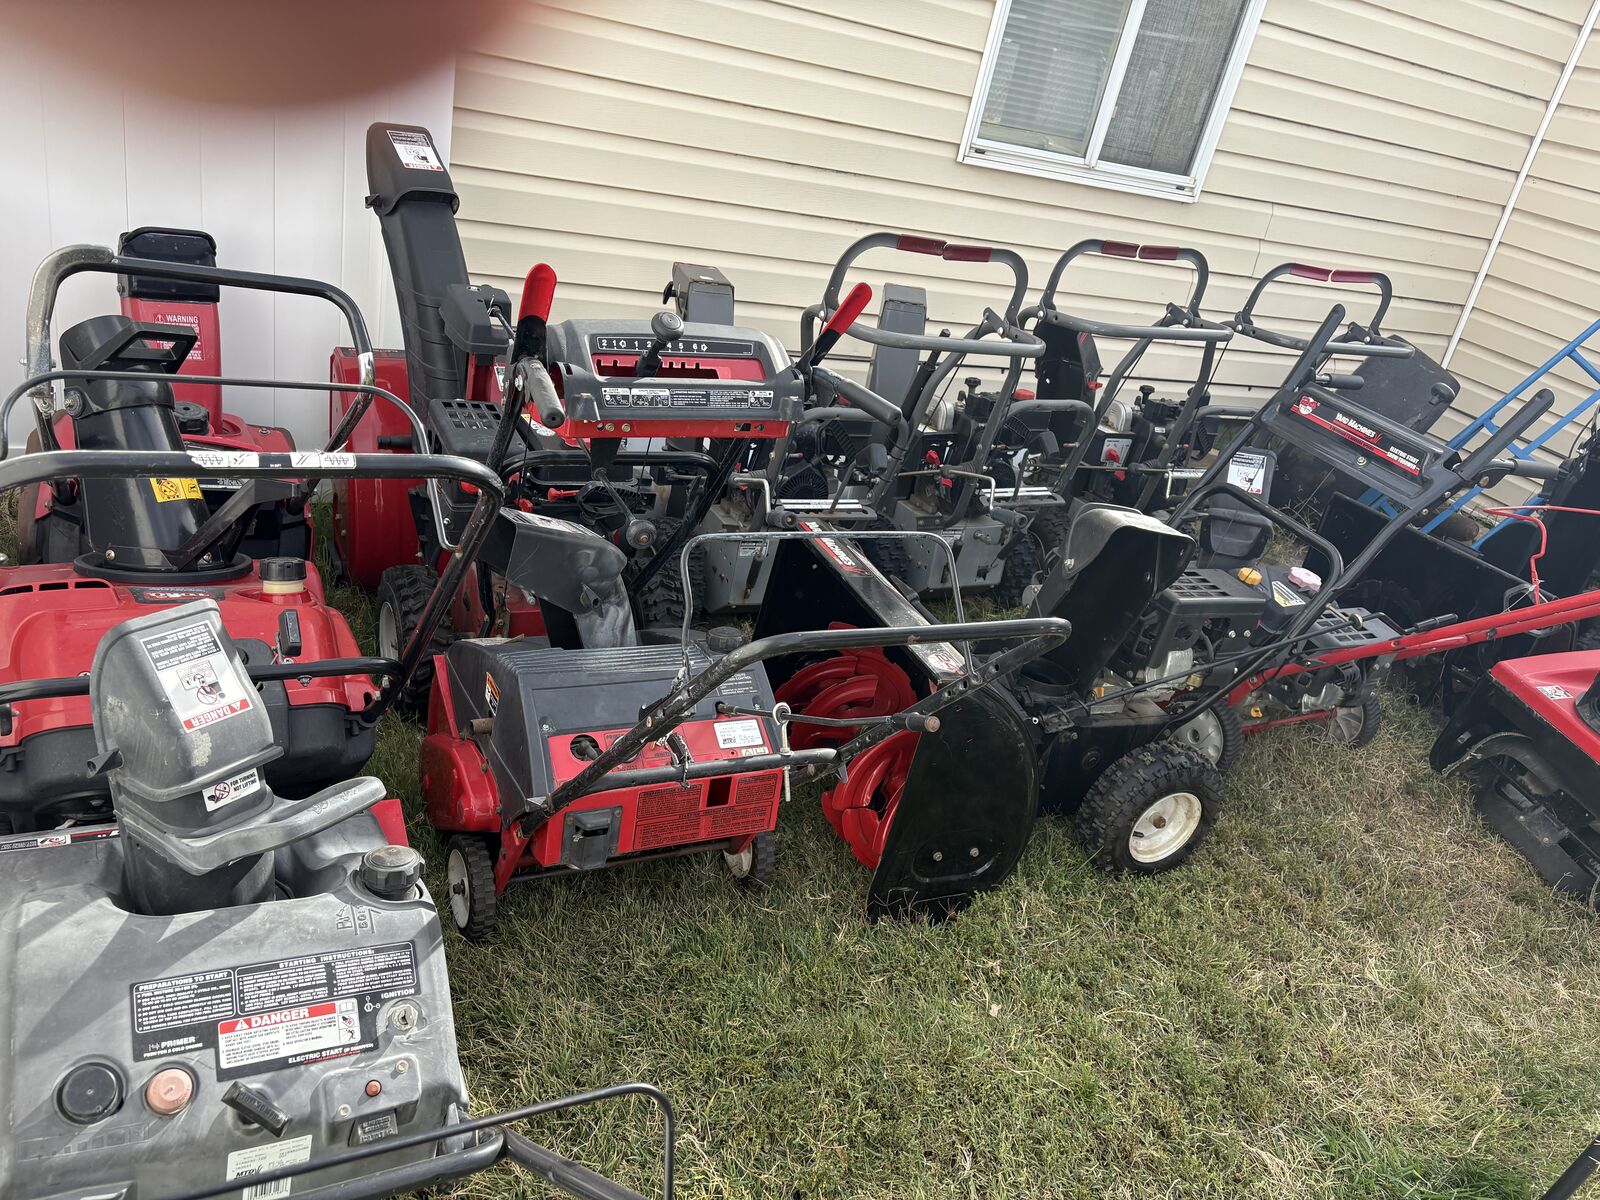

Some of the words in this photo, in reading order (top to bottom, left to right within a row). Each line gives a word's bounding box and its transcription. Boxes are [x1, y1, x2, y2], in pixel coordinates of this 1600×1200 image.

[166, 314, 199, 324] WARNING
[602, 339, 607, 347] 2
[679, 342, 683, 350] 5
[1335, 412, 1350, 425] YARD
[1348, 419, 1376, 439] MACHINES
[191, 708, 231, 727] DANGER
[230, 779, 239, 787] FOR
[239, 771, 256, 784] TURNING
[233, 783, 242, 792] NOT
[241, 778, 257, 790] LIFTING
[279, 957, 316, 968] STARTING
[139, 977, 194, 992] PREPARATIONS
[205, 971, 228, 981] START
[381, 988, 415, 999] IGNITION
[251, 1007, 310, 1028] DANGER
[161, 1036, 196, 1049] PRIMER
[288, 1051, 321, 1064] ELECTRIC
[322, 1047, 344, 1058] START
